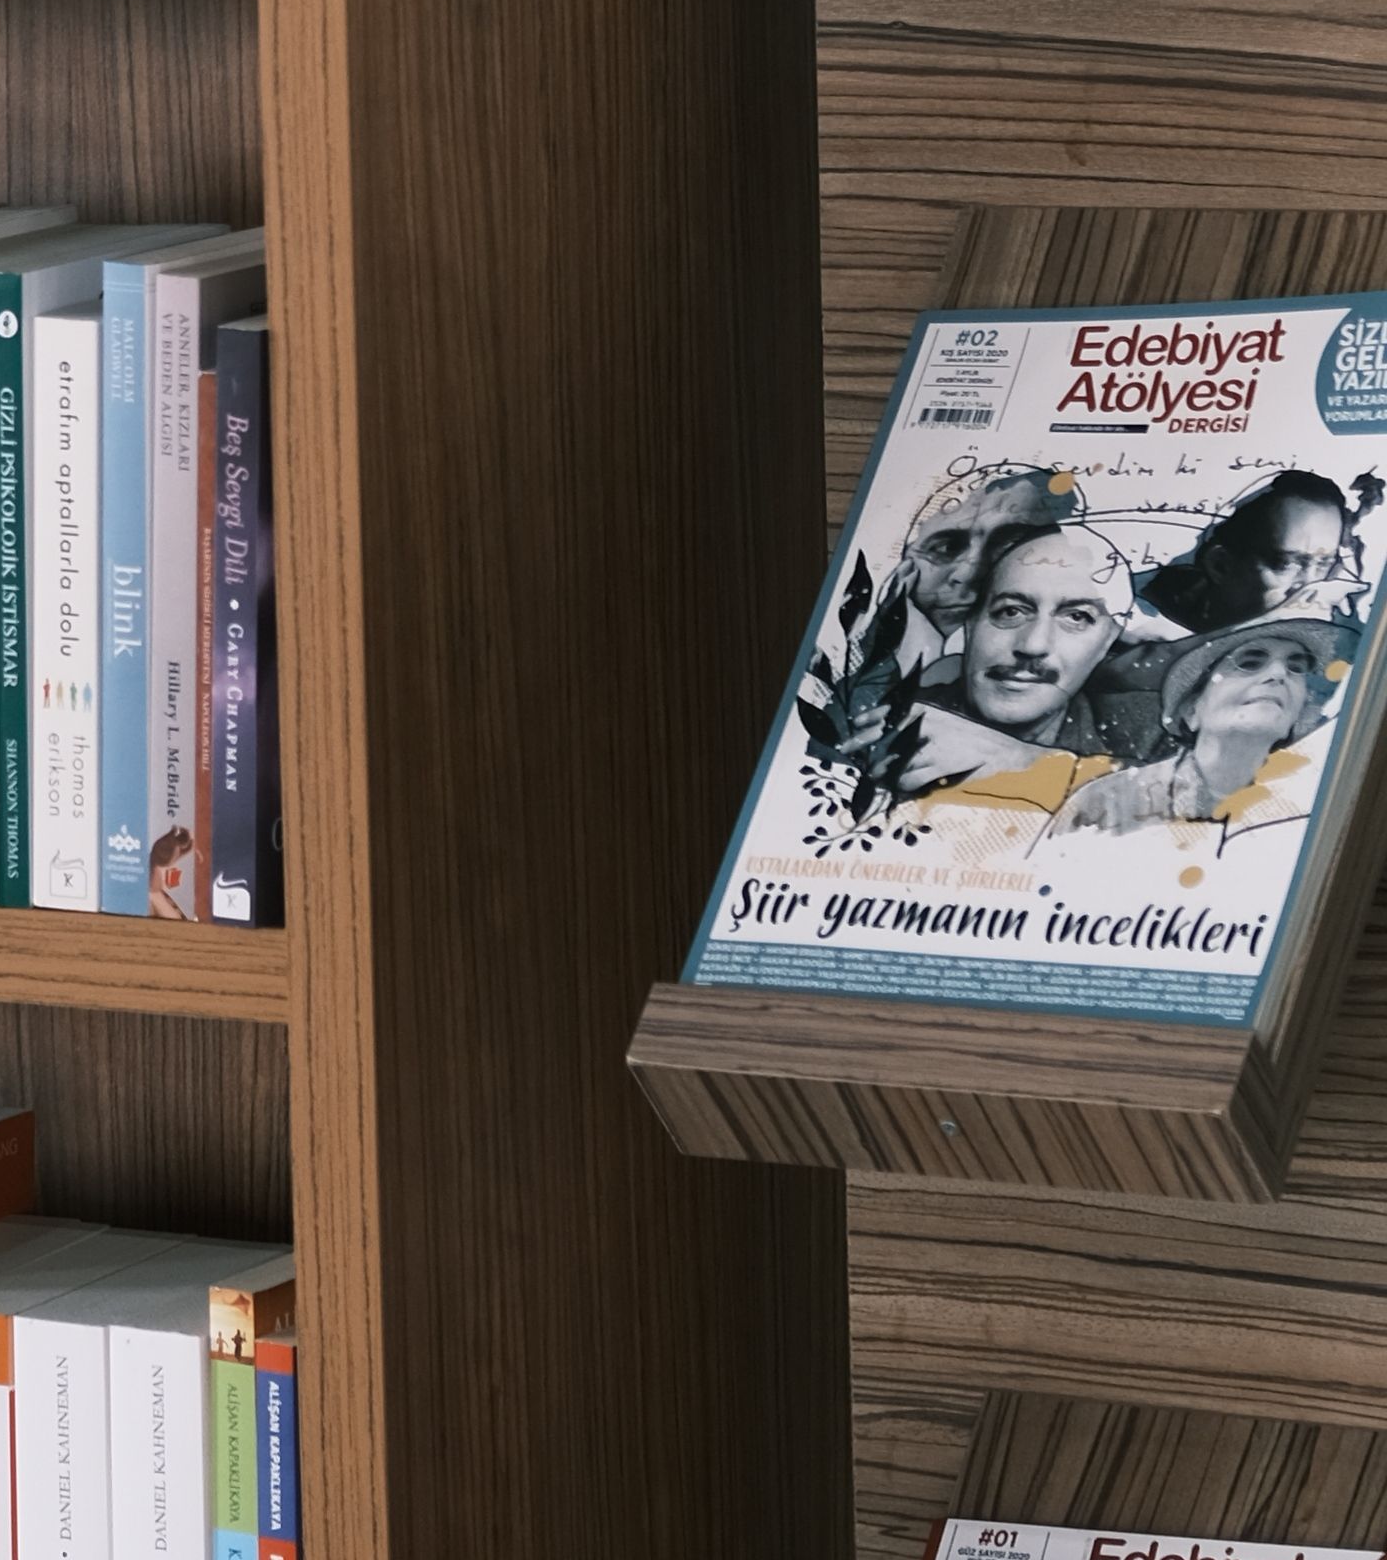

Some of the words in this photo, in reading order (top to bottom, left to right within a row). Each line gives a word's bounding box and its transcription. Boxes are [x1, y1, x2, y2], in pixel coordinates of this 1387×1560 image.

[955, 331, 998, 347] #02
[1070, 319, 1286, 375] Edebiyat
[55, 360, 78, 453] etrafım
[1058, 367, 1260, 423] Atölyesi
[1169, 414, 1248, 434] DERGİSİ
[0, 450, 21, 578] PSİKOLOJİK
[56, 463, 79, 591] aptallarla
[0, 583, 23, 687] İSTİSMAR
[56, 604, 80, 658] dolu
[111, 564, 143, 658] blink
[47, 732, 66, 818] erikson
[71, 734, 89, 820] thomas
[730, 880, 809, 935] Şiir
[816, 884, 1029, 946] yazmanın
[1044, 894, 1269, 957] incelikleri
[977, 1530, 1017, 1547] #01
